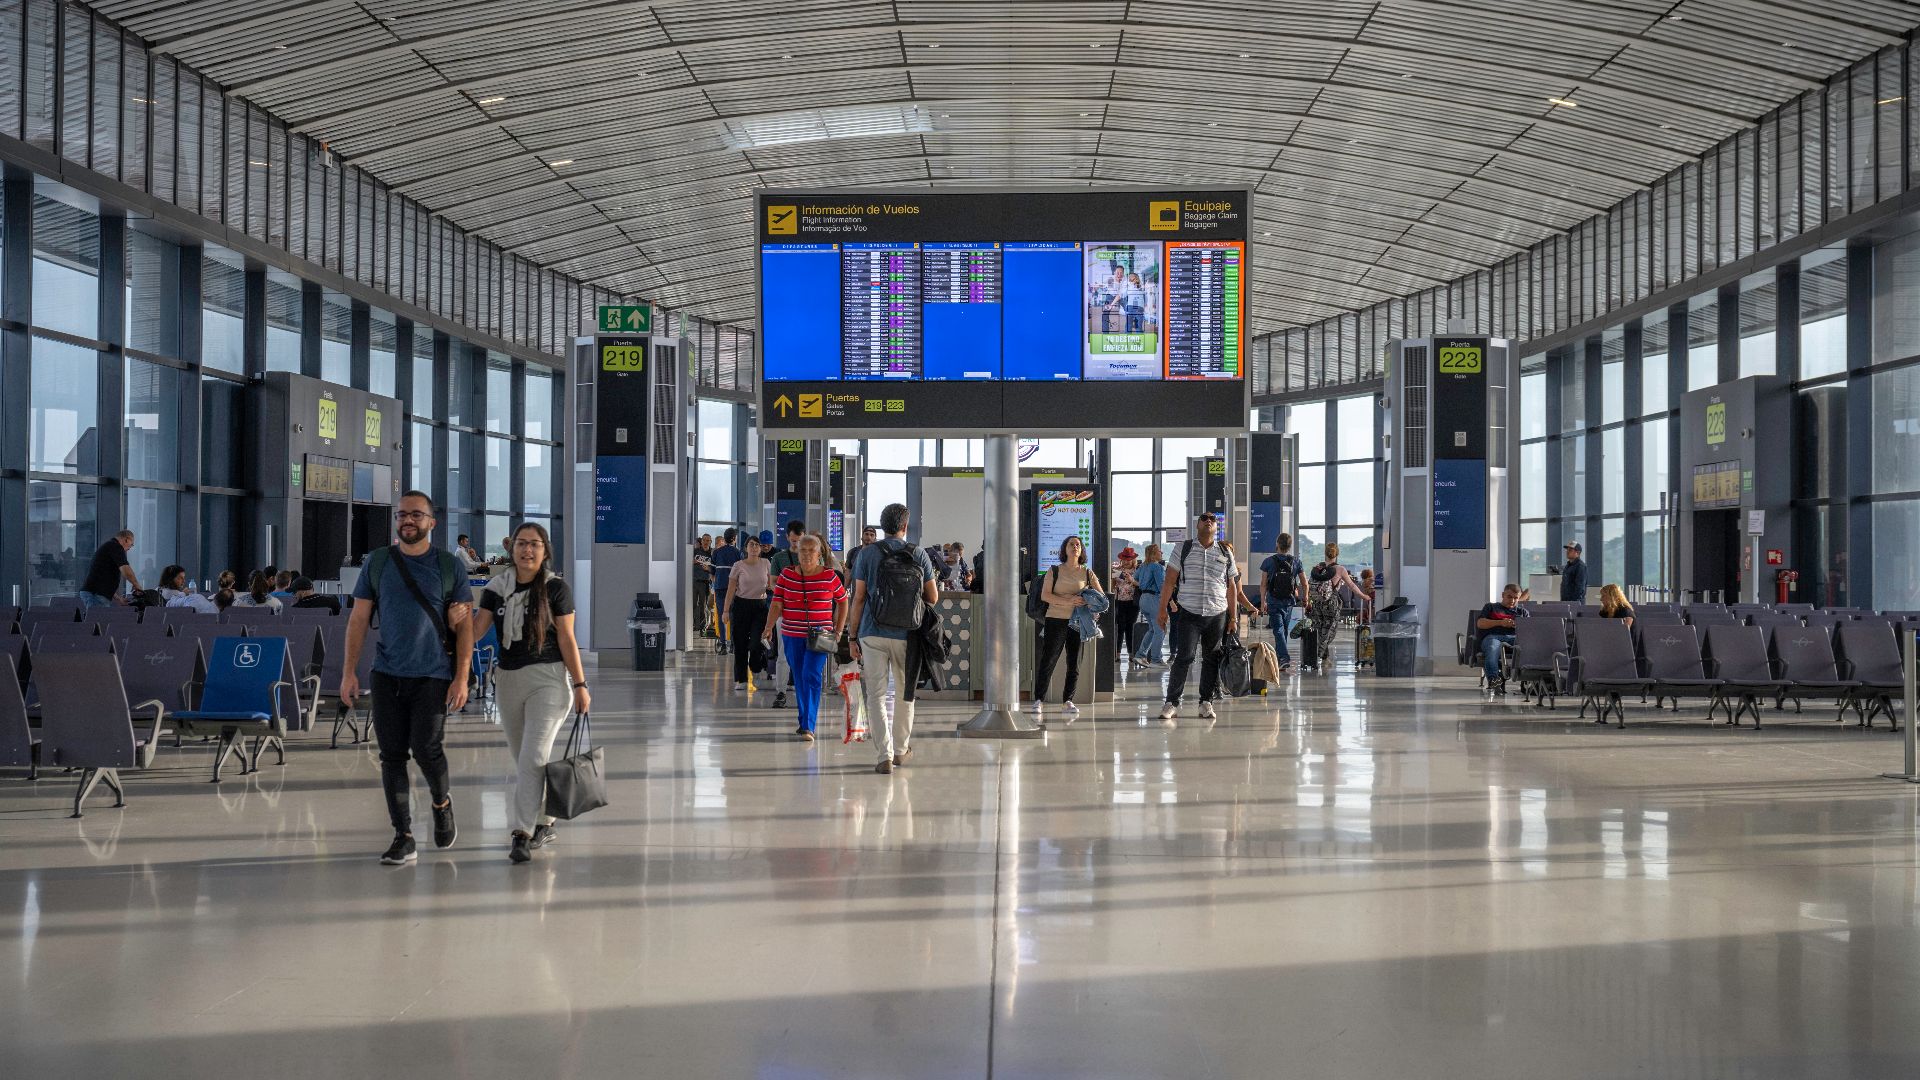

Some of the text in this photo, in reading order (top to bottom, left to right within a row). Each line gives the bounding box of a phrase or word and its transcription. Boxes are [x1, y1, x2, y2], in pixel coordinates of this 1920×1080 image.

[802, 204, 920, 215] Información de Vuelos
[1184, 200, 1232, 212] Equipaje
[802, 216, 822, 224] Flight
[1184, 212, 1216, 220] Baggage
[802, 225, 841, 233] Informação
[1184, 221, 1218, 230] Bagagem
[606, 350, 640, 367] 219
[1442, 352, 1478, 368] 223
[826, 394, 860, 402] Puertas
[866, 401, 882, 410] 219
[887, 401, 904, 410] 223
[320, 406, 336, 432] 219
[1708, 410, 1725, 437] 223
[366, 416, 380, 440] 220
[782, 440, 802, 449] 220
[830, 462, 840, 470] 21
